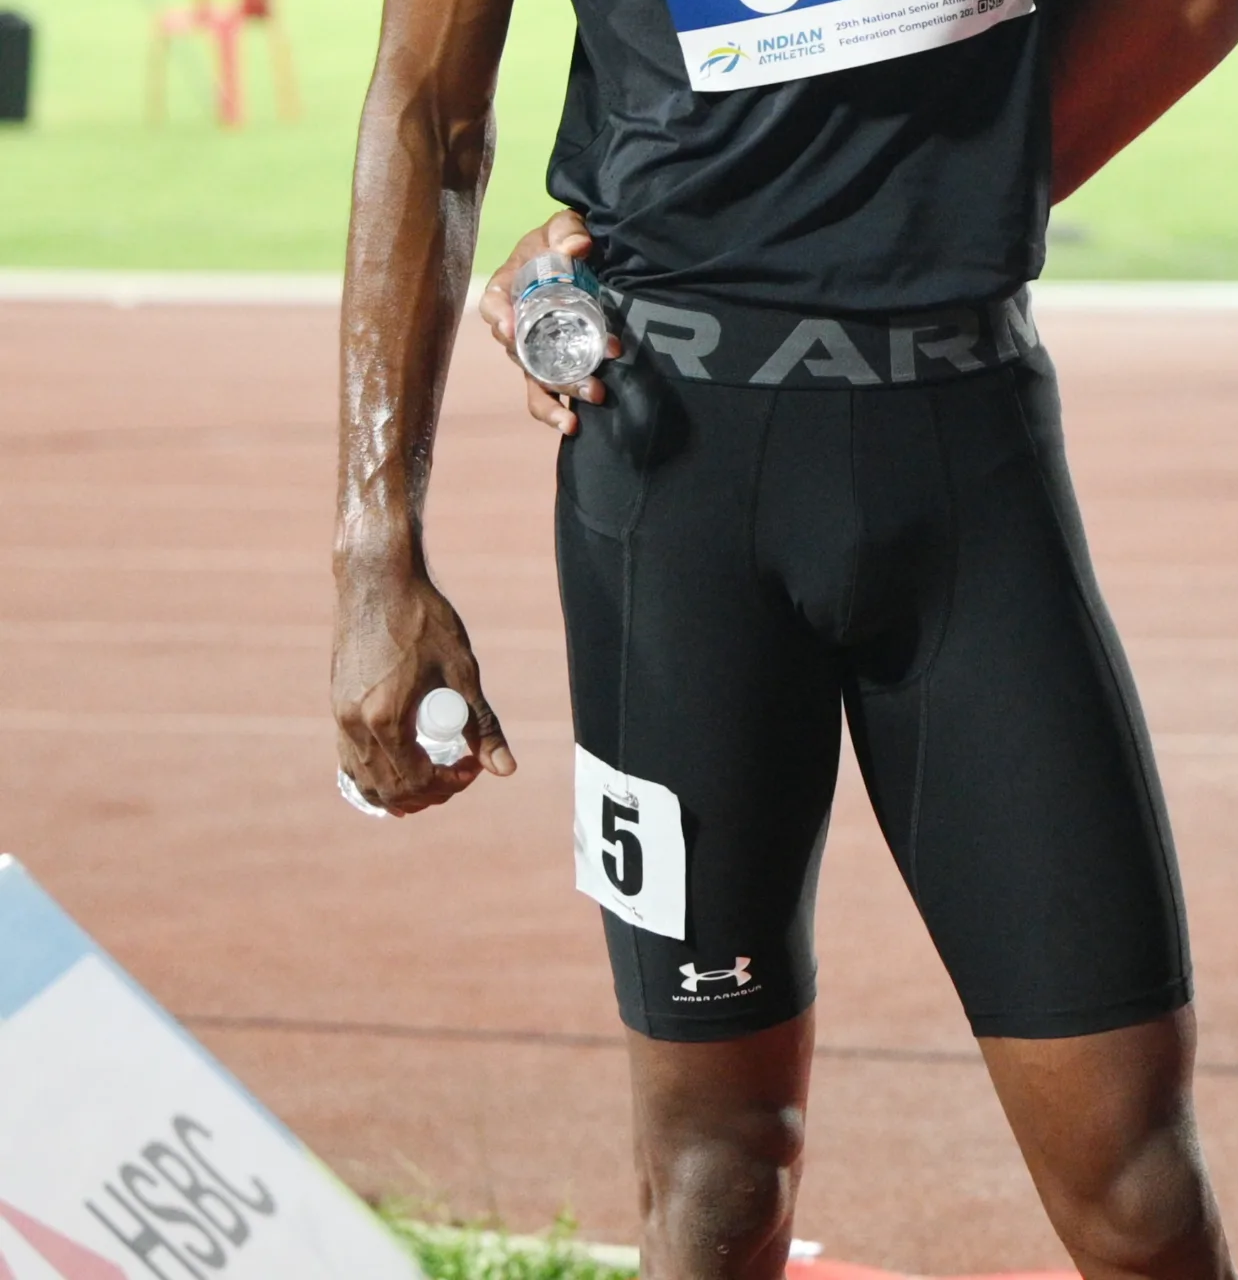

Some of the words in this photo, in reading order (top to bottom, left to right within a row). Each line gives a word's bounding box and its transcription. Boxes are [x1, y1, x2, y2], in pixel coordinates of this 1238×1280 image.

[835, 19, 860, 31] 29th
[862, 8, 906, 25] National
[908, 1, 940, 15] Senior
[838, 28, 897, 46] Federation
[899, 13, 958, 34] Competition
[960, 8, 974, 19] 202
[757, 27, 823, 53] INDIAN
[758, 43, 826, 65] ATHLETICS
[602, 794, 643, 897] 5
[672, 994, 710, 1002] UNDER
[714, 984, 762, 1000] ARMOUR
[84, 1113, 278, 1280] HSBC
